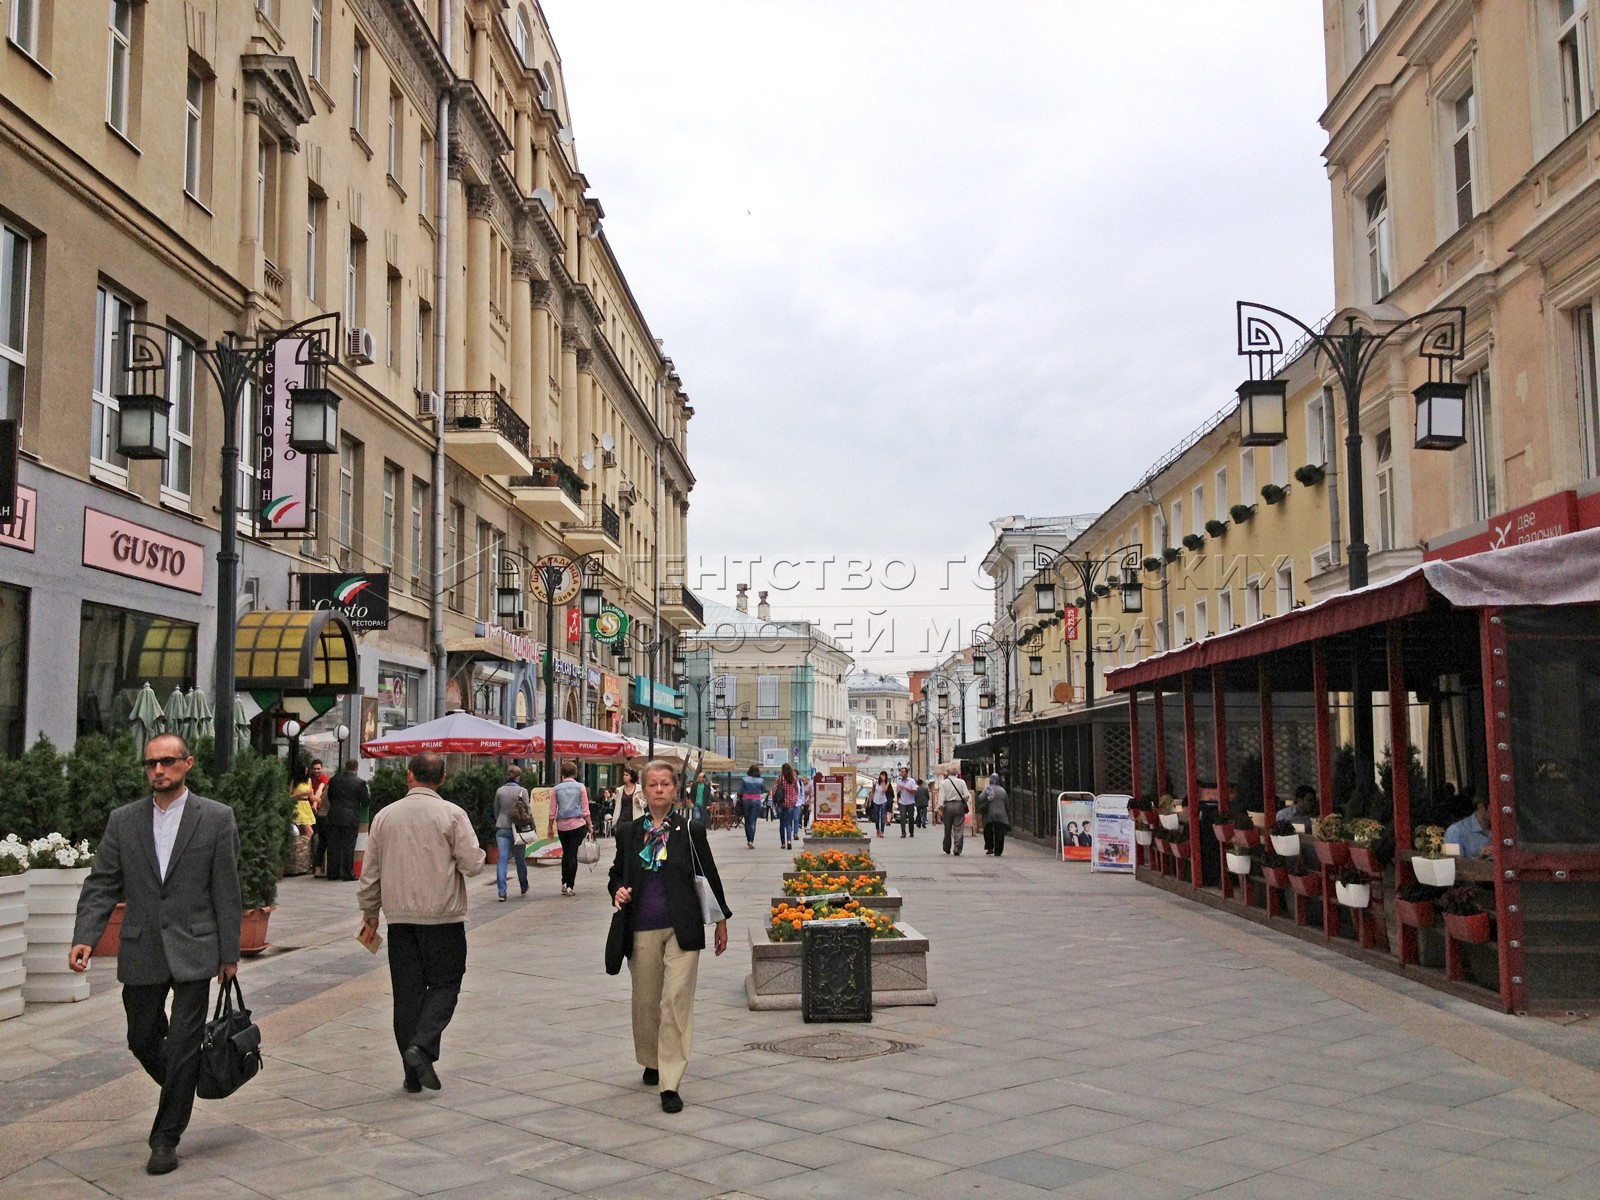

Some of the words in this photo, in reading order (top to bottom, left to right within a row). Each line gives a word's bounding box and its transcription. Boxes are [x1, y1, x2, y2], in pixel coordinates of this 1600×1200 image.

[1517, 511, 1536, 532] две
[537, 590, 572, 604] КОЕЙНЯ
[421, 741, 443, 749] PRIME
[480, 740, 502, 748] PRIME
[578, 742, 598, 750] PRIME
[367, 744, 389, 753] PRIME
